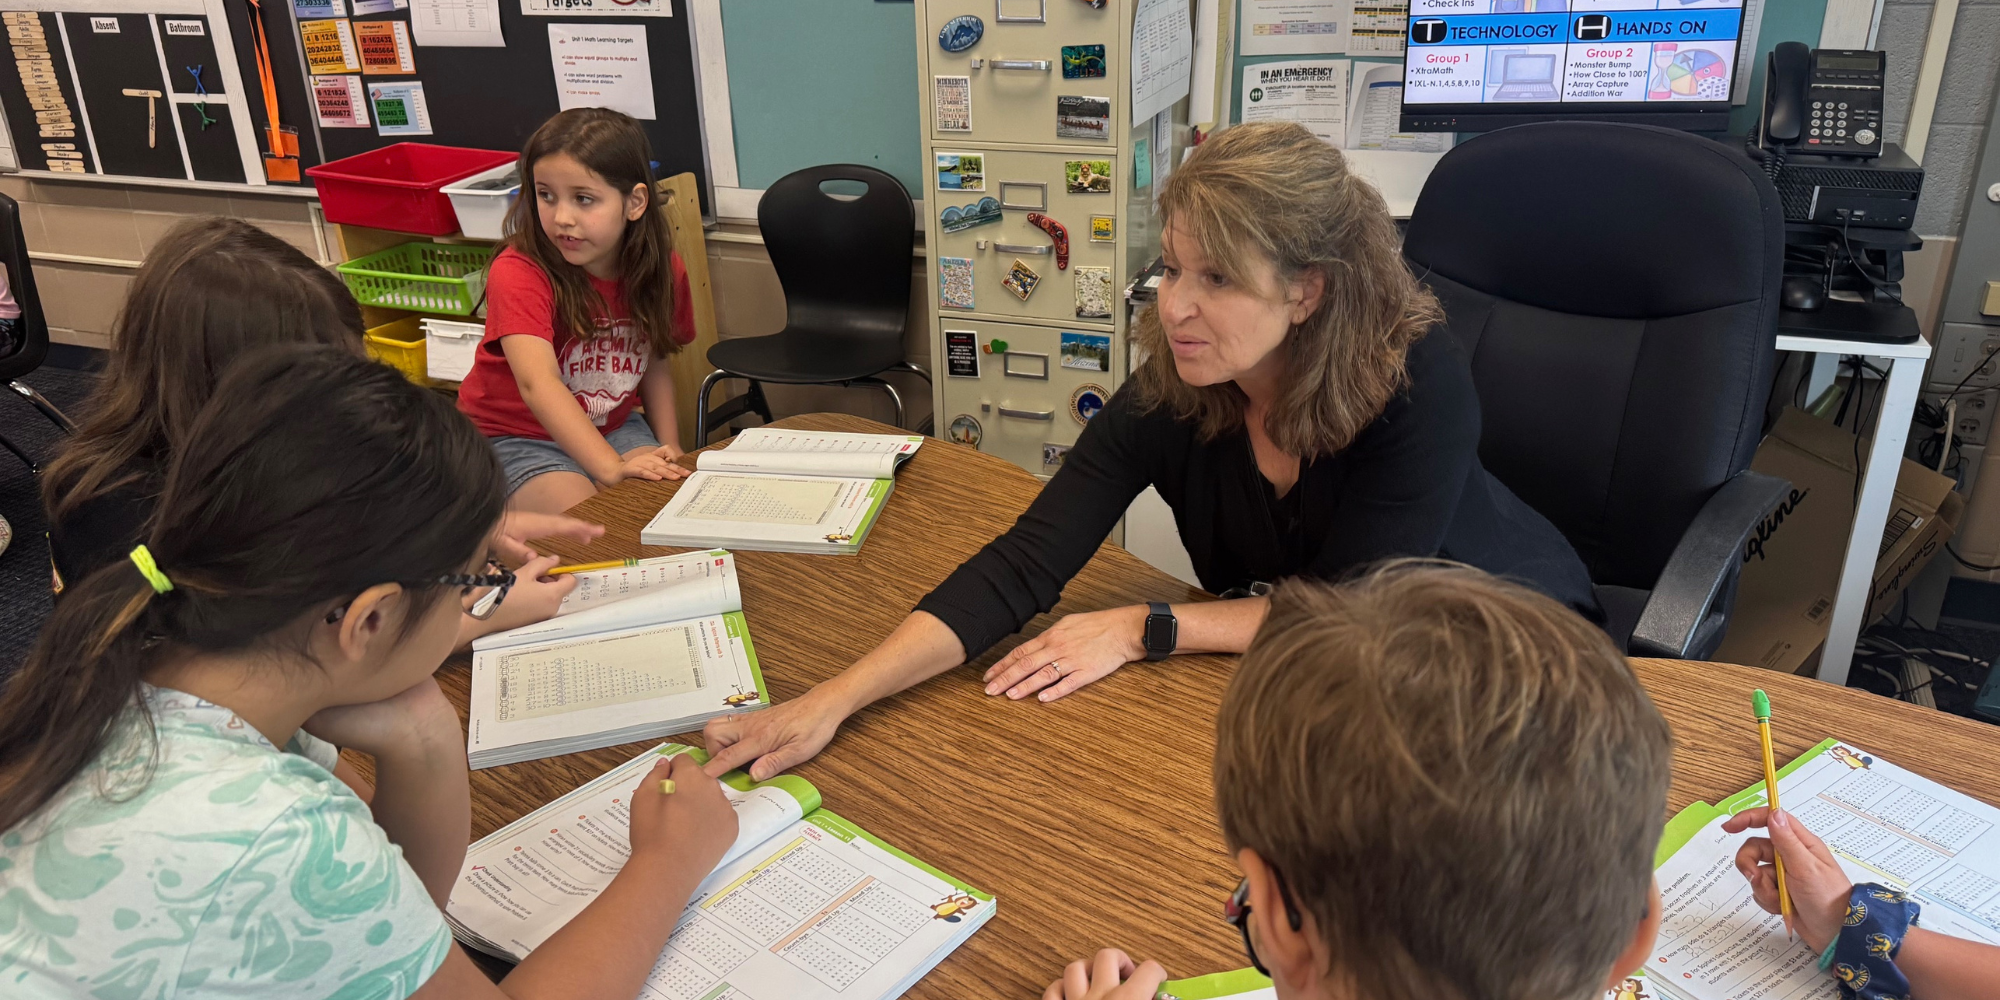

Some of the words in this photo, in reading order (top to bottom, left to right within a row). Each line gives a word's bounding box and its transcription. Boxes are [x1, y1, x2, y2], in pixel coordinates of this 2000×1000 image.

[95, 21, 116, 30] Absent
[169, 23, 201, 32] Bathroom
[1416, 20, 1444, 42] T
[1451, 24, 1558, 39] TECHNOLOGY
[1578, 17, 1607, 38] H
[1616, 22, 1672, 35] HANDS
[1679, 21, 1706, 34] ON
[1426, 54, 1460, 63] Group
[1465, 54, 1469, 62] 1
[1586, 49, 1623, 59] Group
[1627, 48, 1633, 57] 2
[1271, 69, 1282, 77] AN
[1285, 68, 1333, 76] EMERGENCY
[1572, 81, 1594, 89] Array
[569, 355, 605, 378] FIRE
[1876, 530, 1938, 600] Swingline
[827, 826, 843, 838] Lesson
[780, 850, 796, 862] Mixed
[746, 873, 762, 885] Mixed
[762, 868, 771, 876] Up
[1668, 897, 1681, 908] soccer
[1679, 883, 1698, 898] trophies
[1705, 865, 1718, 877] equal
[1717, 855, 1729, 866] rows.
[1672, 873, 1690, 889] problem.
[850, 891, 864, 903] Mixed
[1696, 882, 1714, 896] trophies
[713, 890, 739, 908] Count-bys
[816, 916, 832, 928] Mixed
[1706, 919, 1726, 933] triangles
[1724, 911, 1736, 920] have
[783, 932, 809, 952] Count-bys
[1724, 943, 1741, 954] picture,
[1746, 924, 1764, 938] students
[1708, 966, 1720, 974] rows
[1731, 947, 1750, 959] students
[1752, 937, 1764, 945] each
[1761, 930, 1772, 938] row.
[1770, 921, 1782, 930] How
[1708, 972, 1727, 985] students
[1732, 990, 1750, 1000] Tickets
[1760, 973, 1774, 983] school
